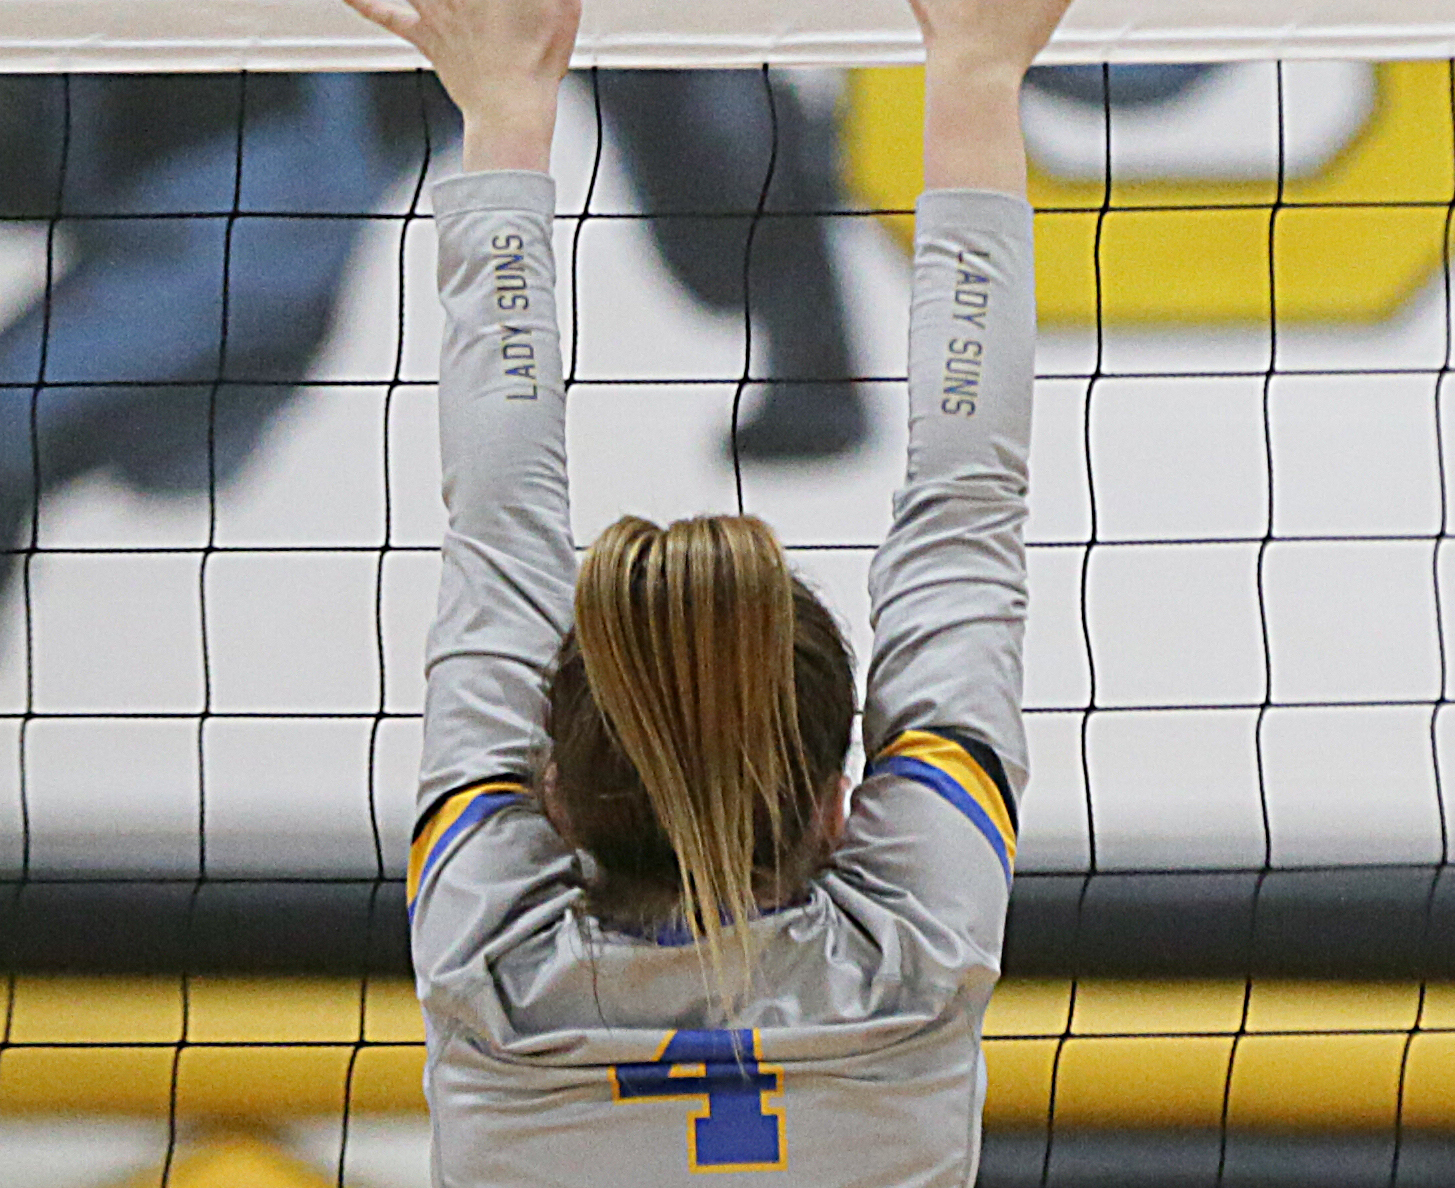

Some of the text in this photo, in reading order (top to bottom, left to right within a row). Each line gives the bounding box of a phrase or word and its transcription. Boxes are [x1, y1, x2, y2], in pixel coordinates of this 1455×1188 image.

[491, 233, 539, 400] LADY SUNS
[941, 250, 991, 417] LADY SUNS
[608, 1026, 788, 1174] 4
